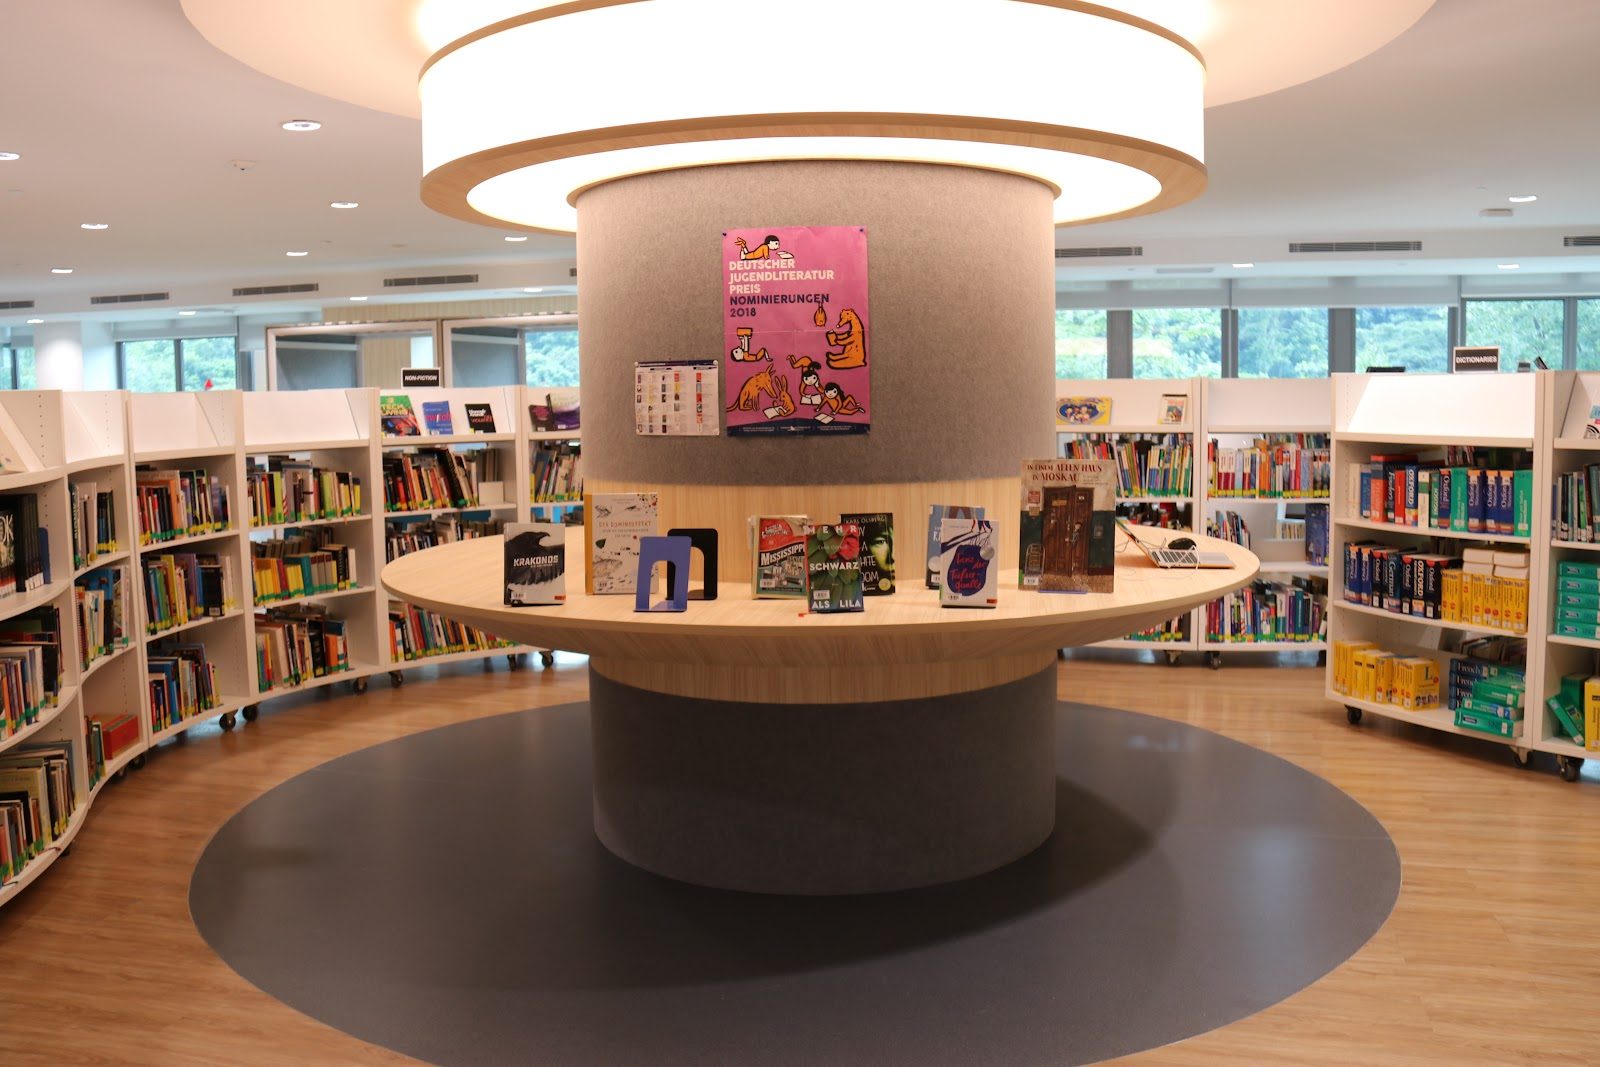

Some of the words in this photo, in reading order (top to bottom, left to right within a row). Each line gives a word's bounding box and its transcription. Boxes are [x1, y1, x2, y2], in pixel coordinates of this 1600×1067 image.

[729, 259, 796, 270] DEUTSCHER
[728, 270, 835, 284] JUGENDLITERATUR
[729, 284, 761, 294] PREIS
[730, 294, 830, 305] NOMINIERUNGEN
[730, 308, 757, 317] 2018
[1082, 464, 1102, 472] HAUS
[1042, 472, 1079, 482] MOSKAU
[513, 555, 559, 567] KRAKONOS
[809, 561, 859, 571] SCHWARZ
[860, 556, 876, 567] HITE
[812, 600, 830, 609] ALS
[840, 599, 861, 608] LILA
